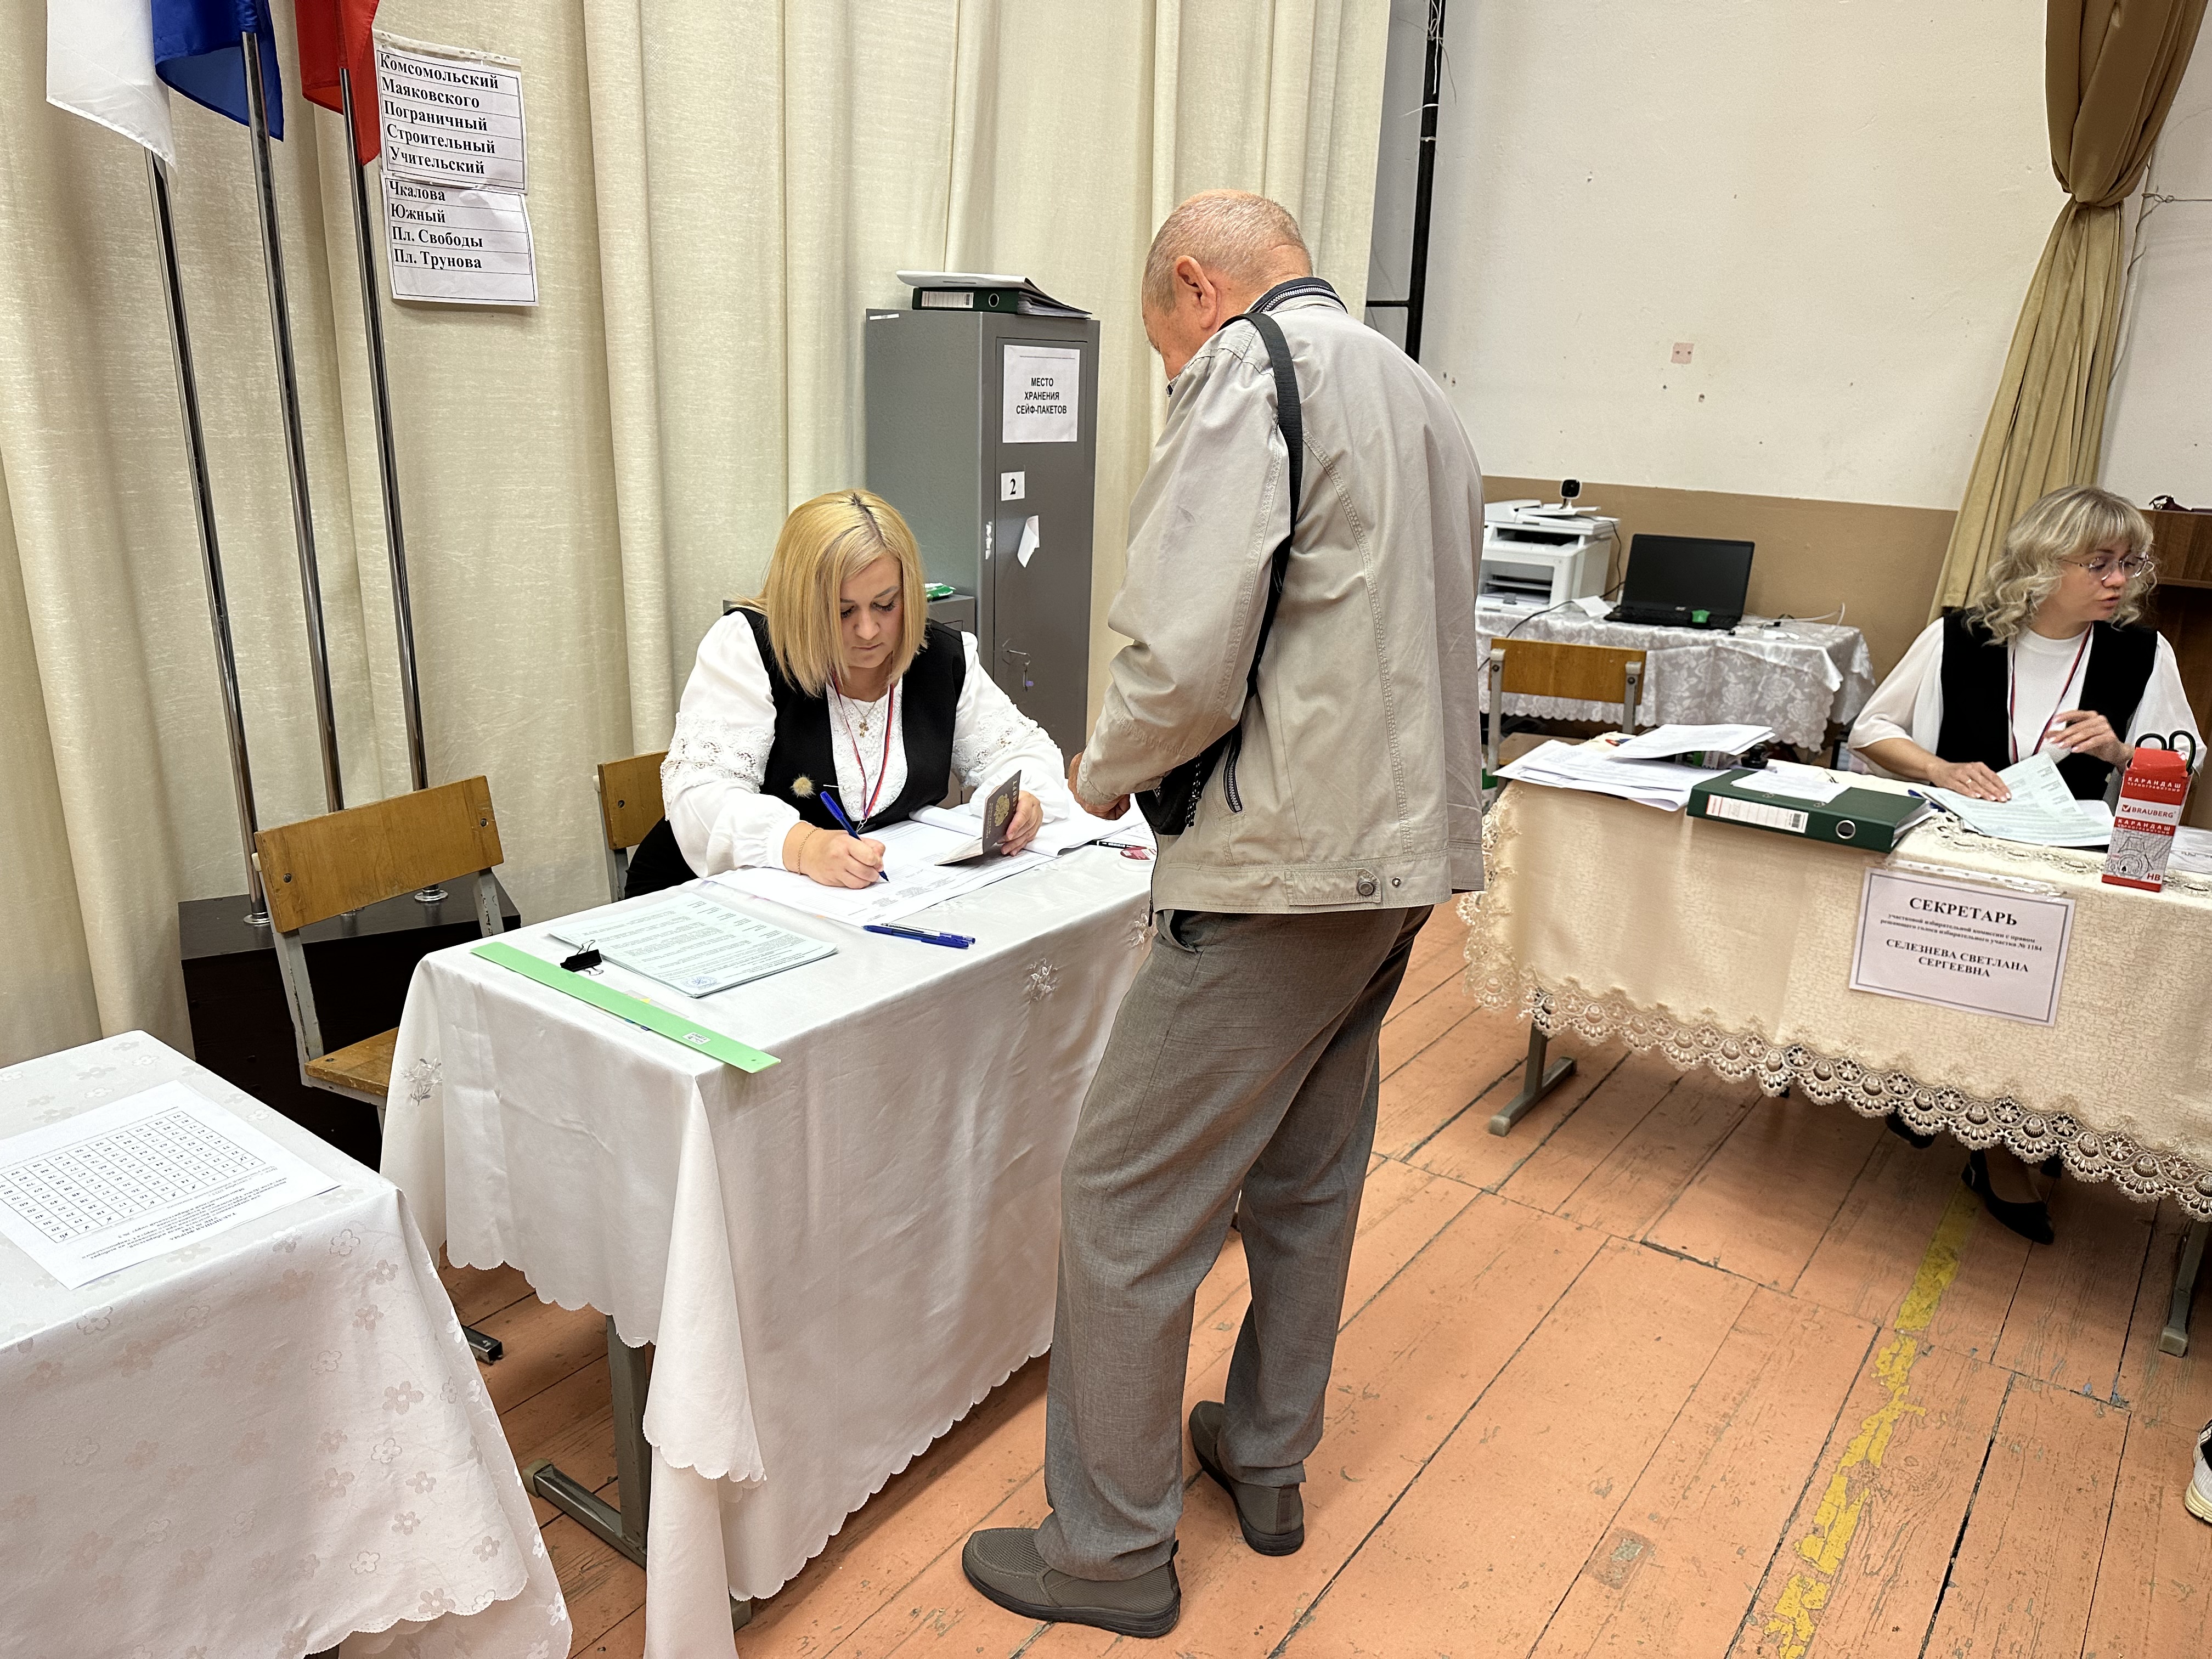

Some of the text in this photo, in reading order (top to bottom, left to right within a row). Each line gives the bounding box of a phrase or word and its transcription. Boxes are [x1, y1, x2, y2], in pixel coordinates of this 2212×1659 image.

[380, 53, 498, 89] Комсомольский
[382, 75, 479, 108] Маяковского
[383, 100, 487, 131] Пограничный
[386, 122, 495, 153] Строительный
[389, 146, 484, 174] Учительский
[390, 180, 446, 201] Чкалова
[390, 203, 445, 223] Южный
[392, 226, 483, 248] Пл. Свободы
[394, 248, 482, 268] Пл. Трунова
[1031, 378, 1054, 387] МЕСТО
[1024, 391, 1059, 400] ХРАНЕНИЯ
[1016, 404, 1067, 414] СЕЙФ-ПАКЕТОВ
[1010, 478, 1016, 495] 2
[2128, 777, 2181, 788] КАРАНДАШ
[2132, 807, 2173, 818] BRAUBERG
[2118, 819, 2170, 831] КАРАНДАШ
[1910, 898, 2017, 925] СЕКРЕТАРЬ
[1886, 939, 2028, 972] СЕЛЕЗНЕВА СВЕТЛАНА
[1919, 957, 1990, 977] СЕРГЕЕВНА
